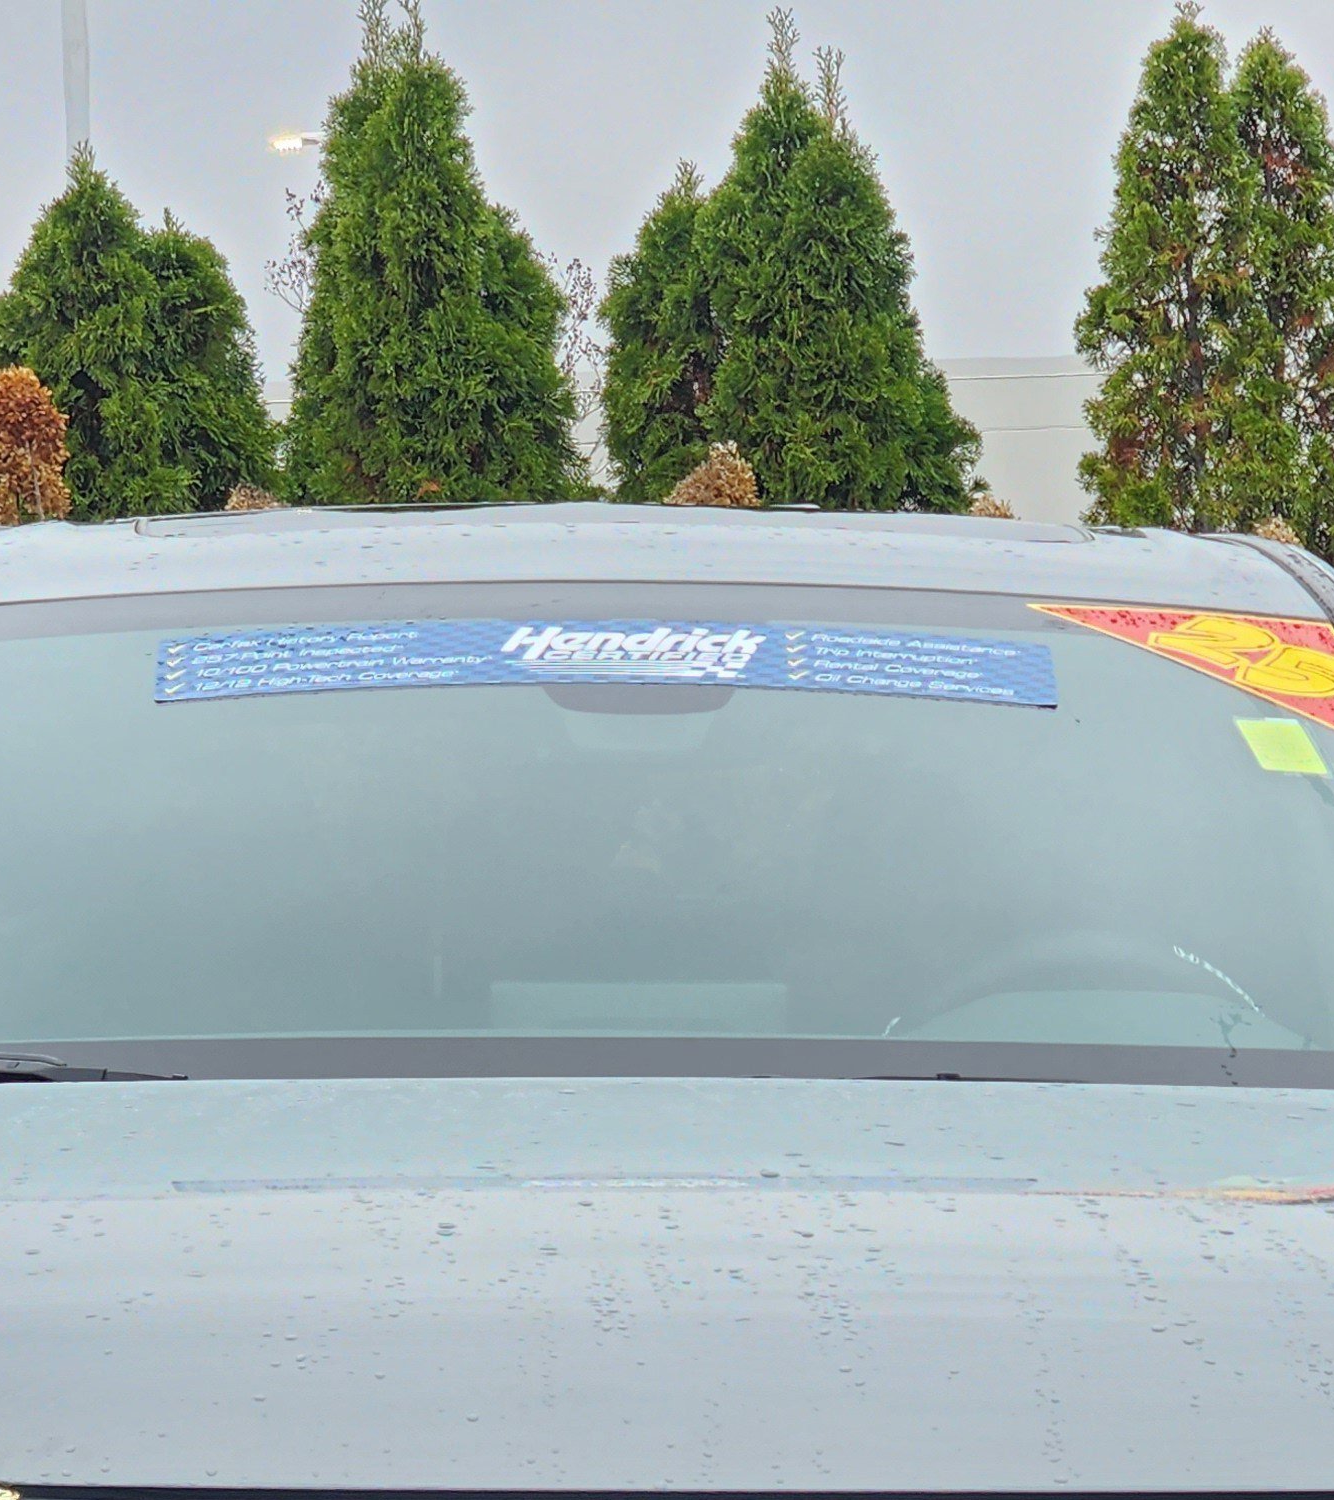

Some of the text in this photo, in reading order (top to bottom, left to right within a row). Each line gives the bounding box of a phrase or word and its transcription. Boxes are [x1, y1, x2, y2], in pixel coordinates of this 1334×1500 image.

[193, 638, 261, 652] Carfax
[347, 631, 419, 643] Report
[500, 626, 767, 661] Hendrick
[810, 633, 901, 647] Roadside
[542, 650, 754, 663] CERTIFIED
[273, 657, 384, 672] Powertrain
[813, 659, 879, 672] Rental
[814, 673, 1015, 696] Oil Change Services
